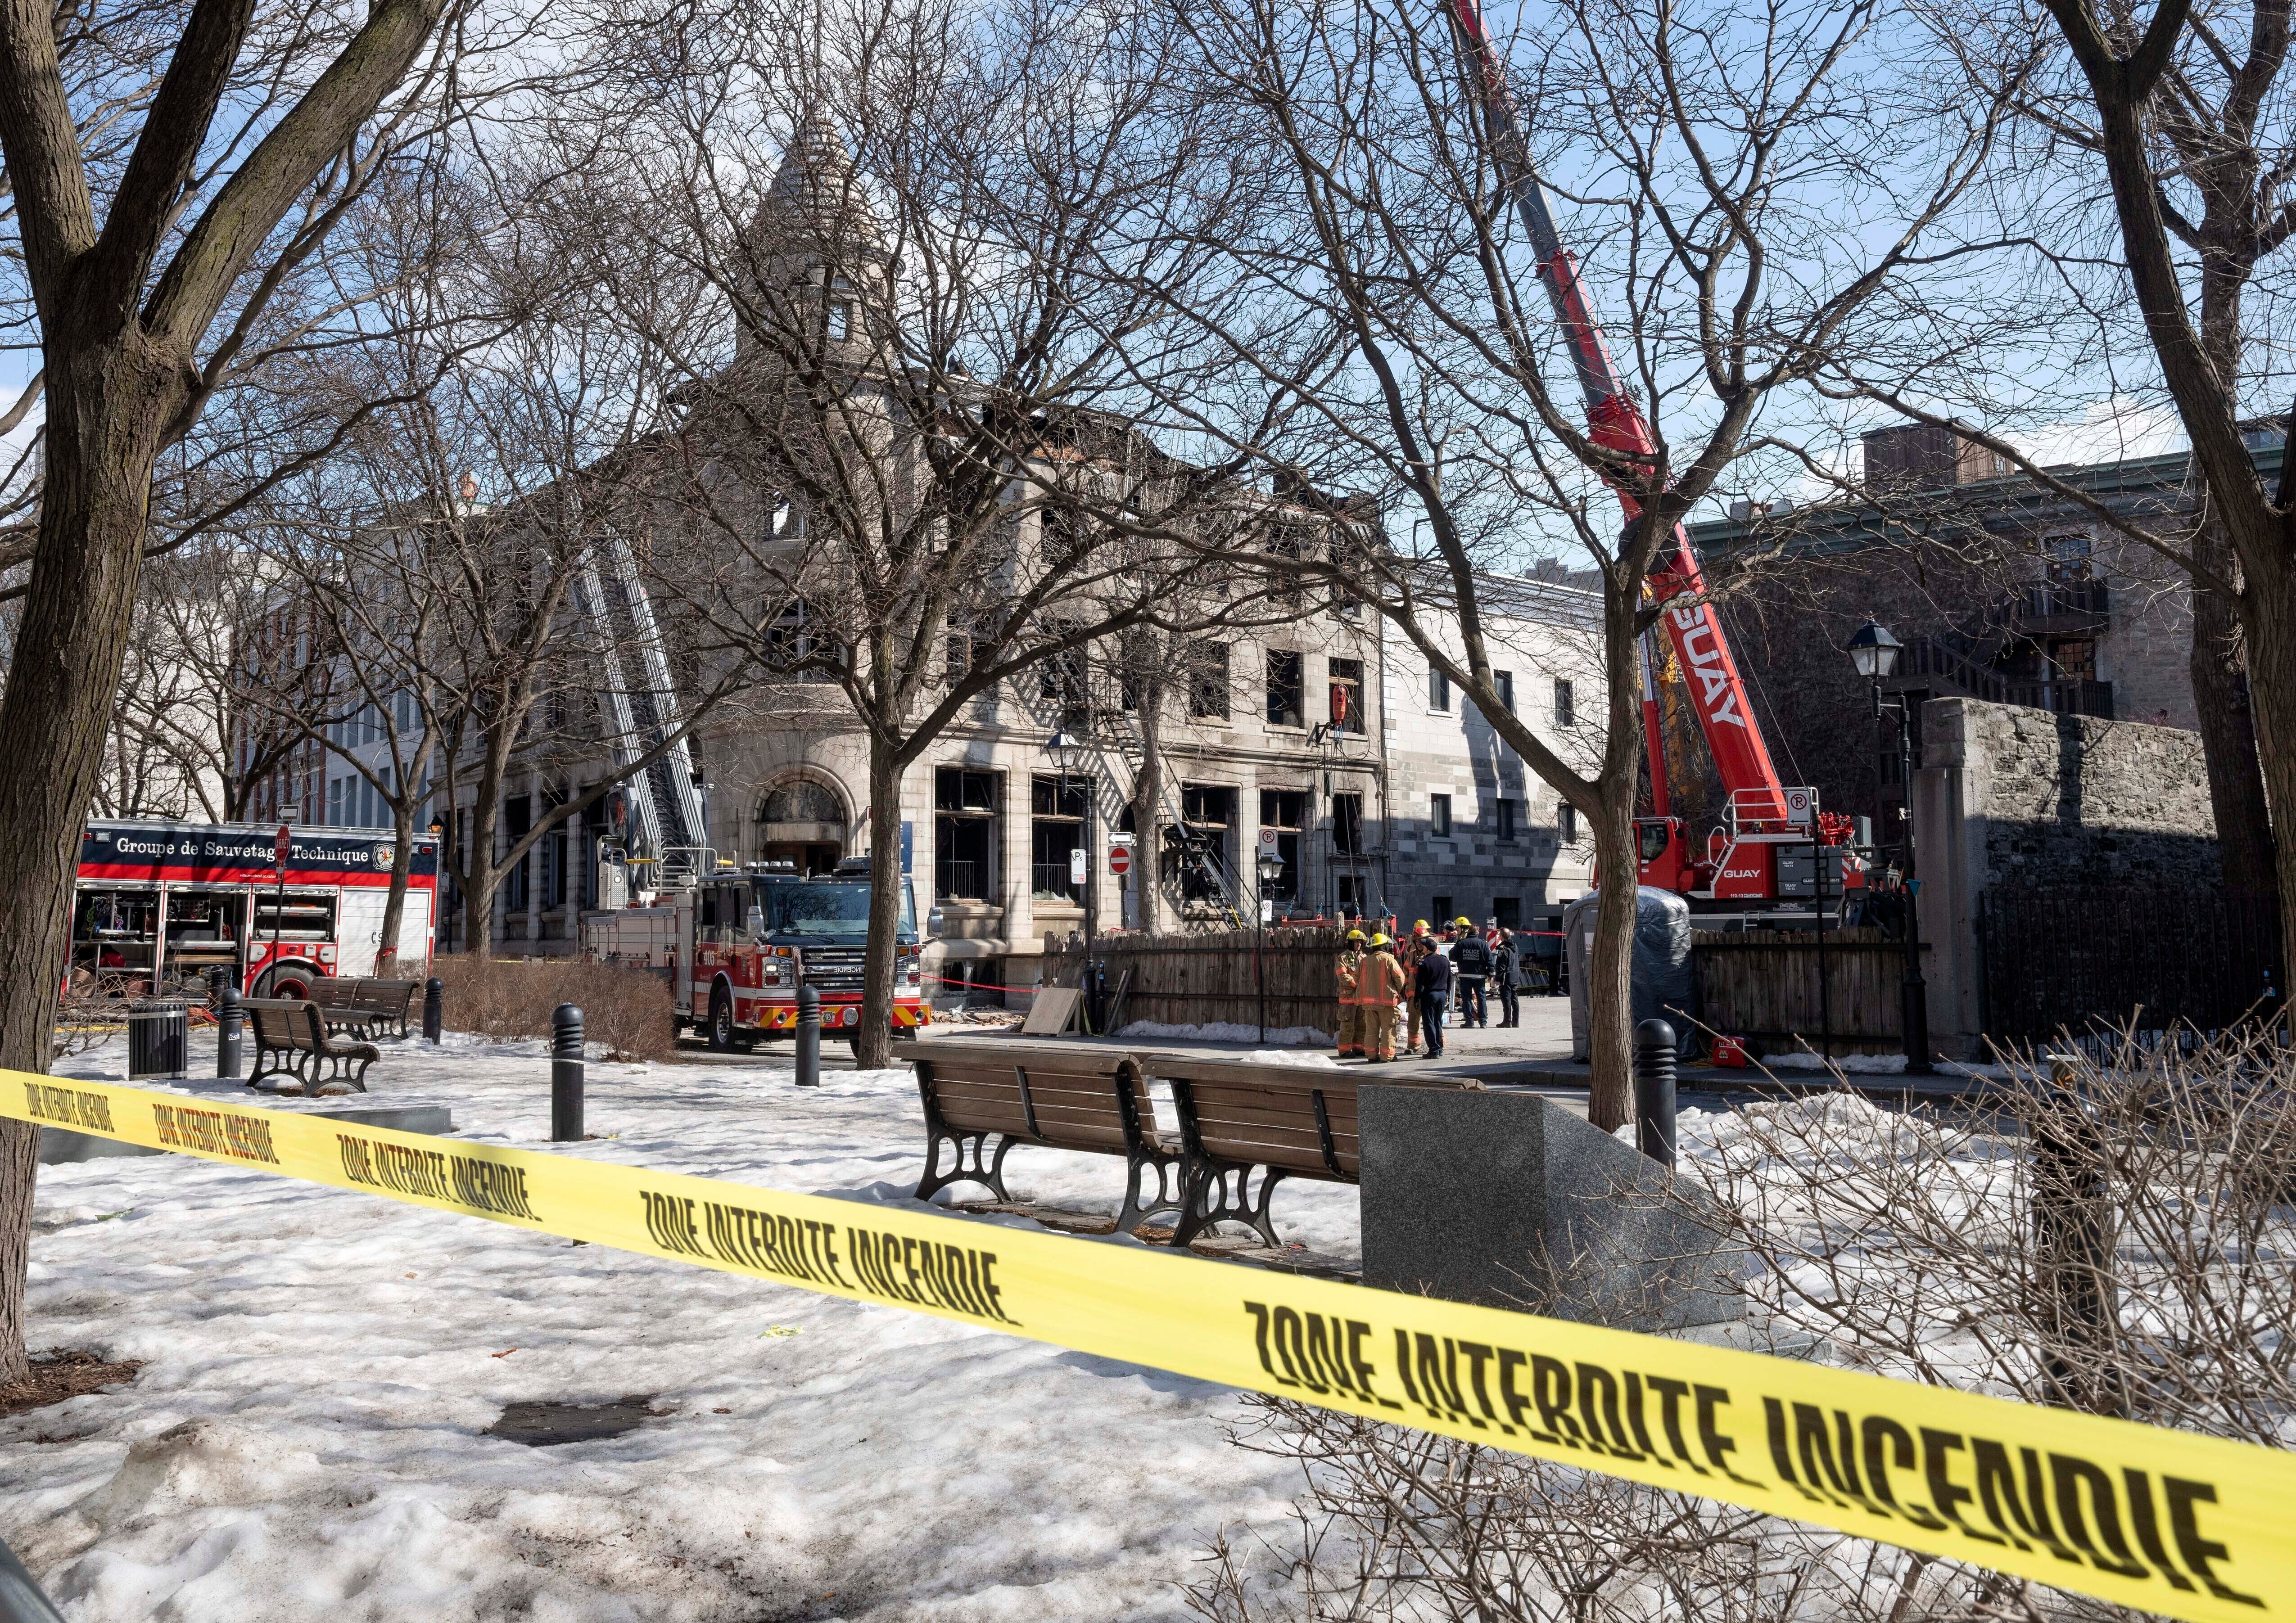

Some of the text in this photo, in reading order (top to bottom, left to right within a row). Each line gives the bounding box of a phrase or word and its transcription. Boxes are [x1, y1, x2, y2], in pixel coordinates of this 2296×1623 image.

[1672, 590, 1746, 728] GUAY
[117, 838, 368, 865] Groupe de Sauvetag Technique
[276, 836, 289, 849] ARRÊT
[1724, 870, 1761, 878] GUAY
[703, 950, 715, 966] 405
[24, 1082, 115, 1133] ZONE INTERDITE INCENDIE
[152, 1103, 281, 1165] ZONE INTERDITE INCENDIE
[335, 1134, 543, 1222] ZONE INTERDITE INCENDIE
[640, 1190, 1024, 1328] ZONE INTERDITE INCENDIE
[1243, 1300, 2269, 1610] ZONE INTERDITE INCENDIE
